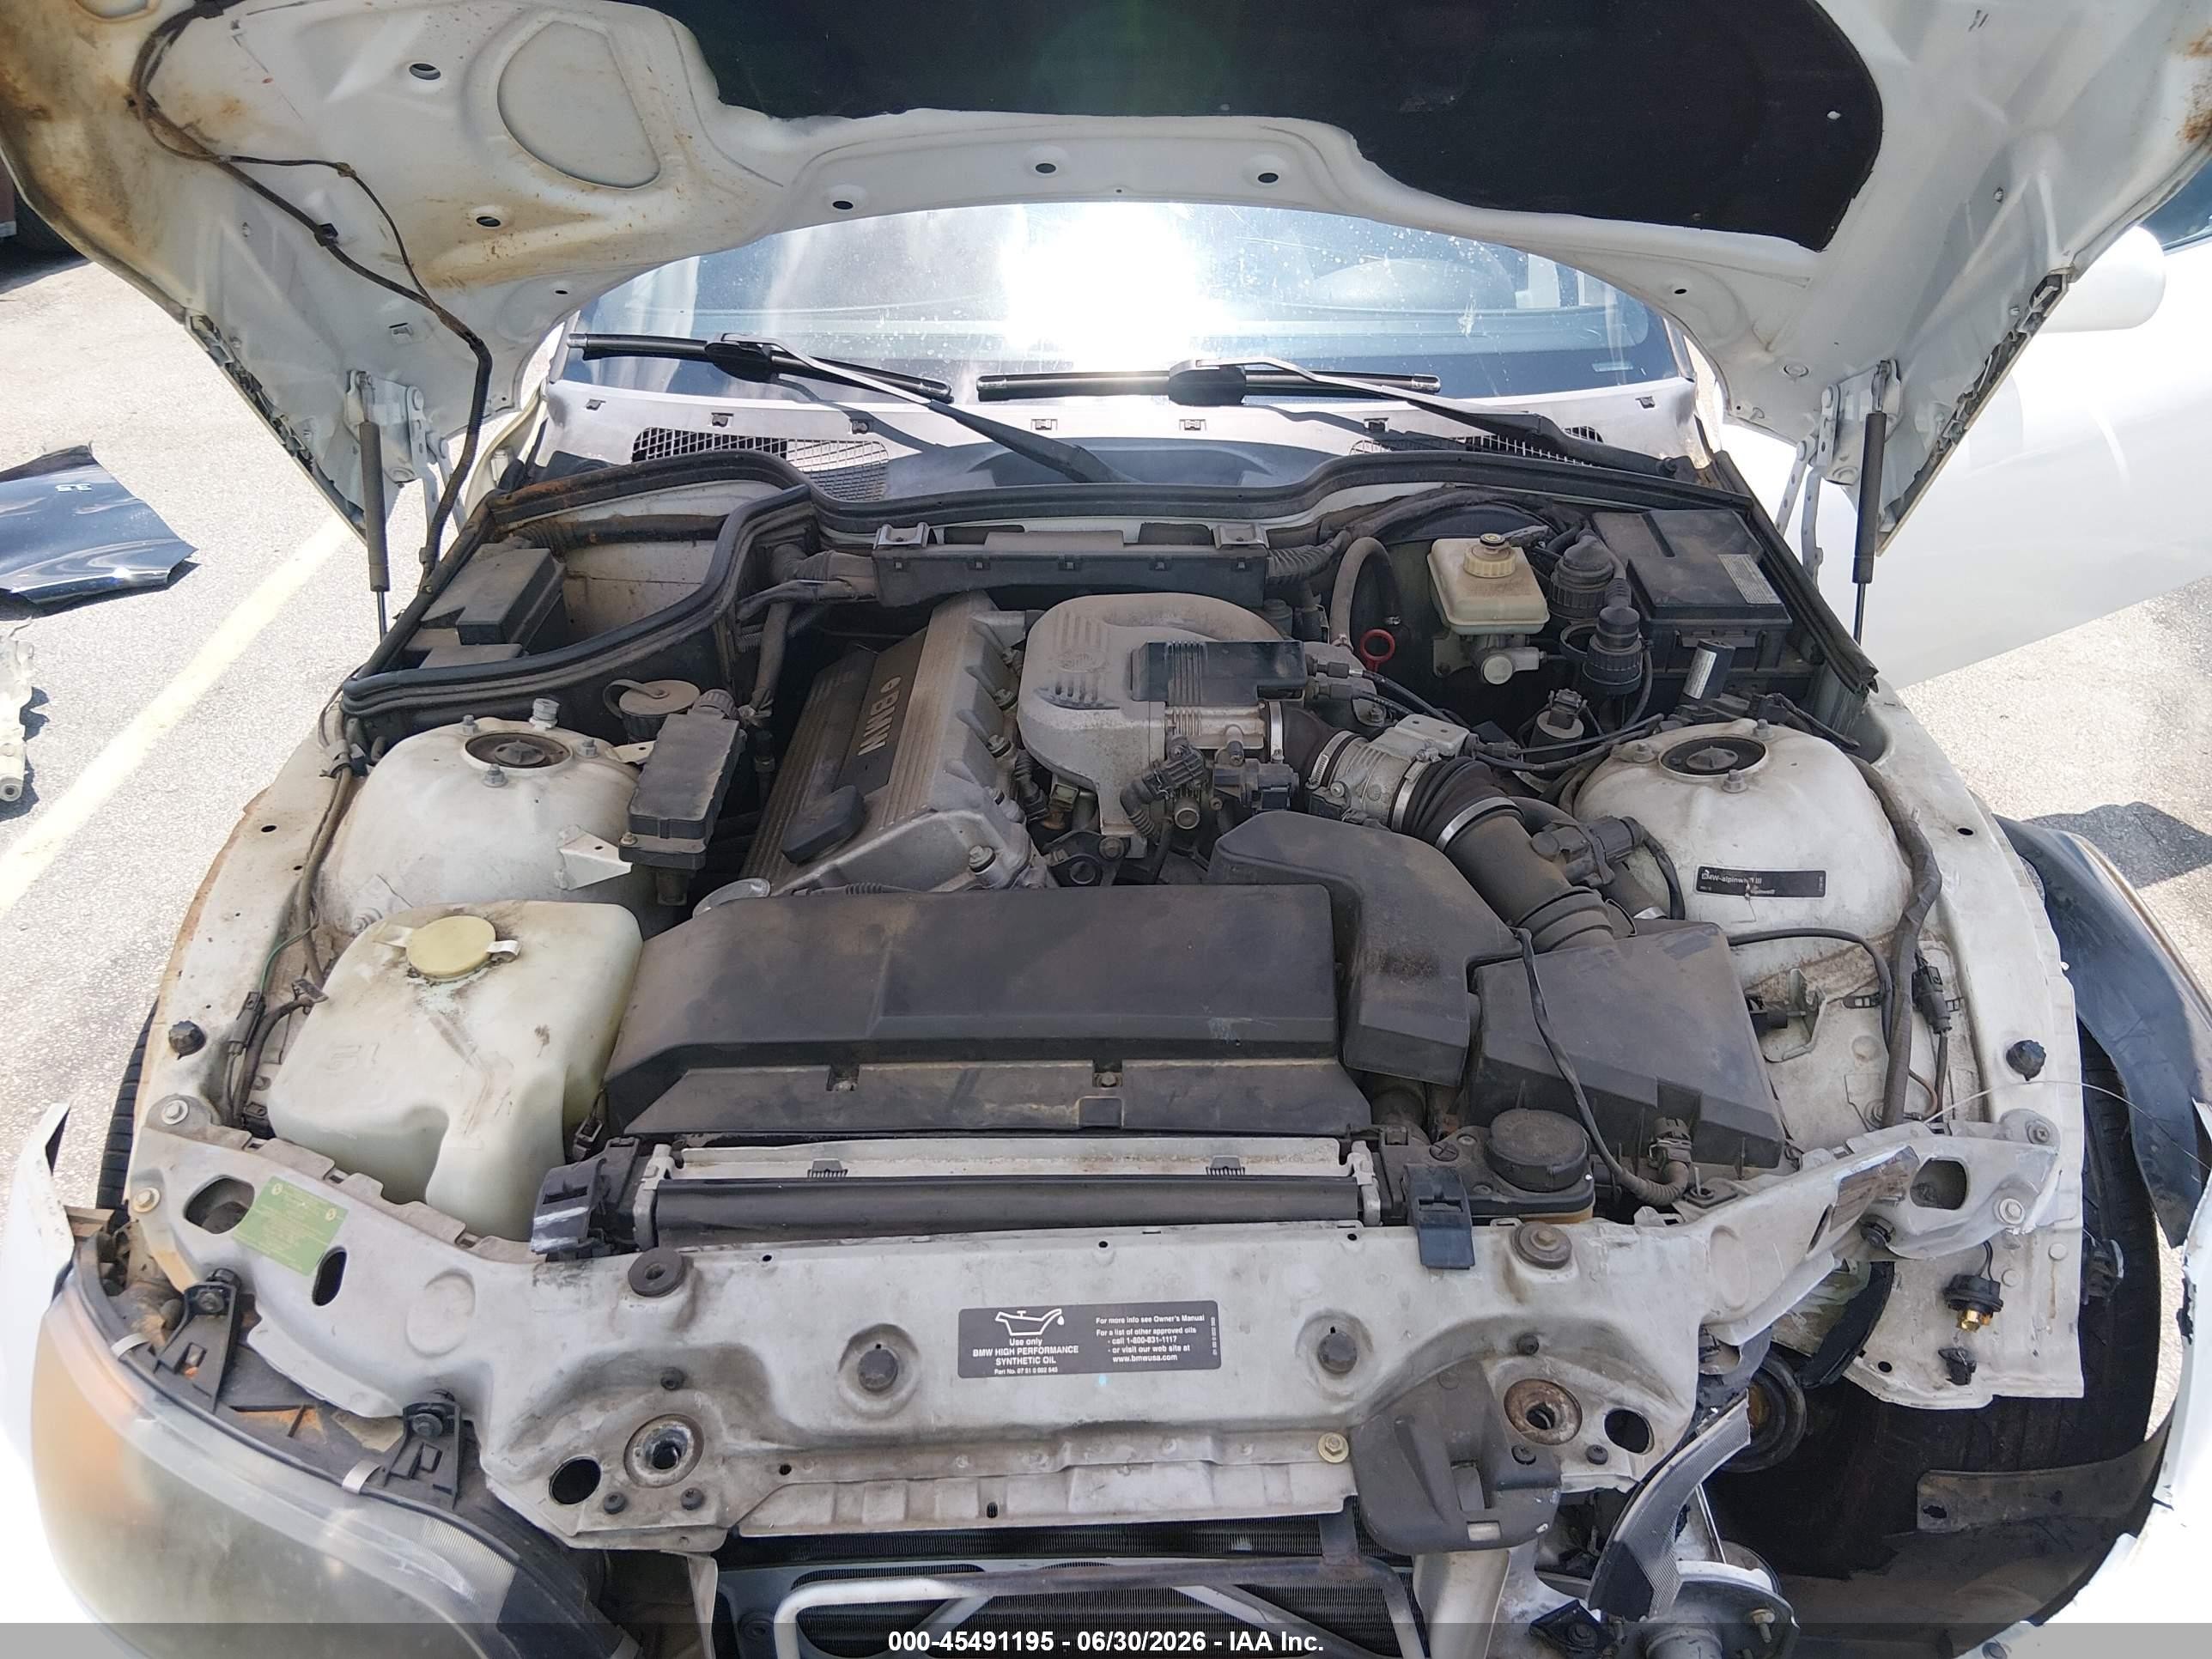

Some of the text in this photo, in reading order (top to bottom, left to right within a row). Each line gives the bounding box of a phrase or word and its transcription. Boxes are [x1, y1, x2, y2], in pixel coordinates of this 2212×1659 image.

[858, 690, 900, 756] BMW
[1152, 1327, 1182, 1335] approved
[1026, 1337, 1042, 1346] only
[995, 1347, 1014, 1356] HIGH
[1017, 1346, 1079, 1355] PERFORMANCE
[995, 1357, 1041, 1365] SYNTHETIC
